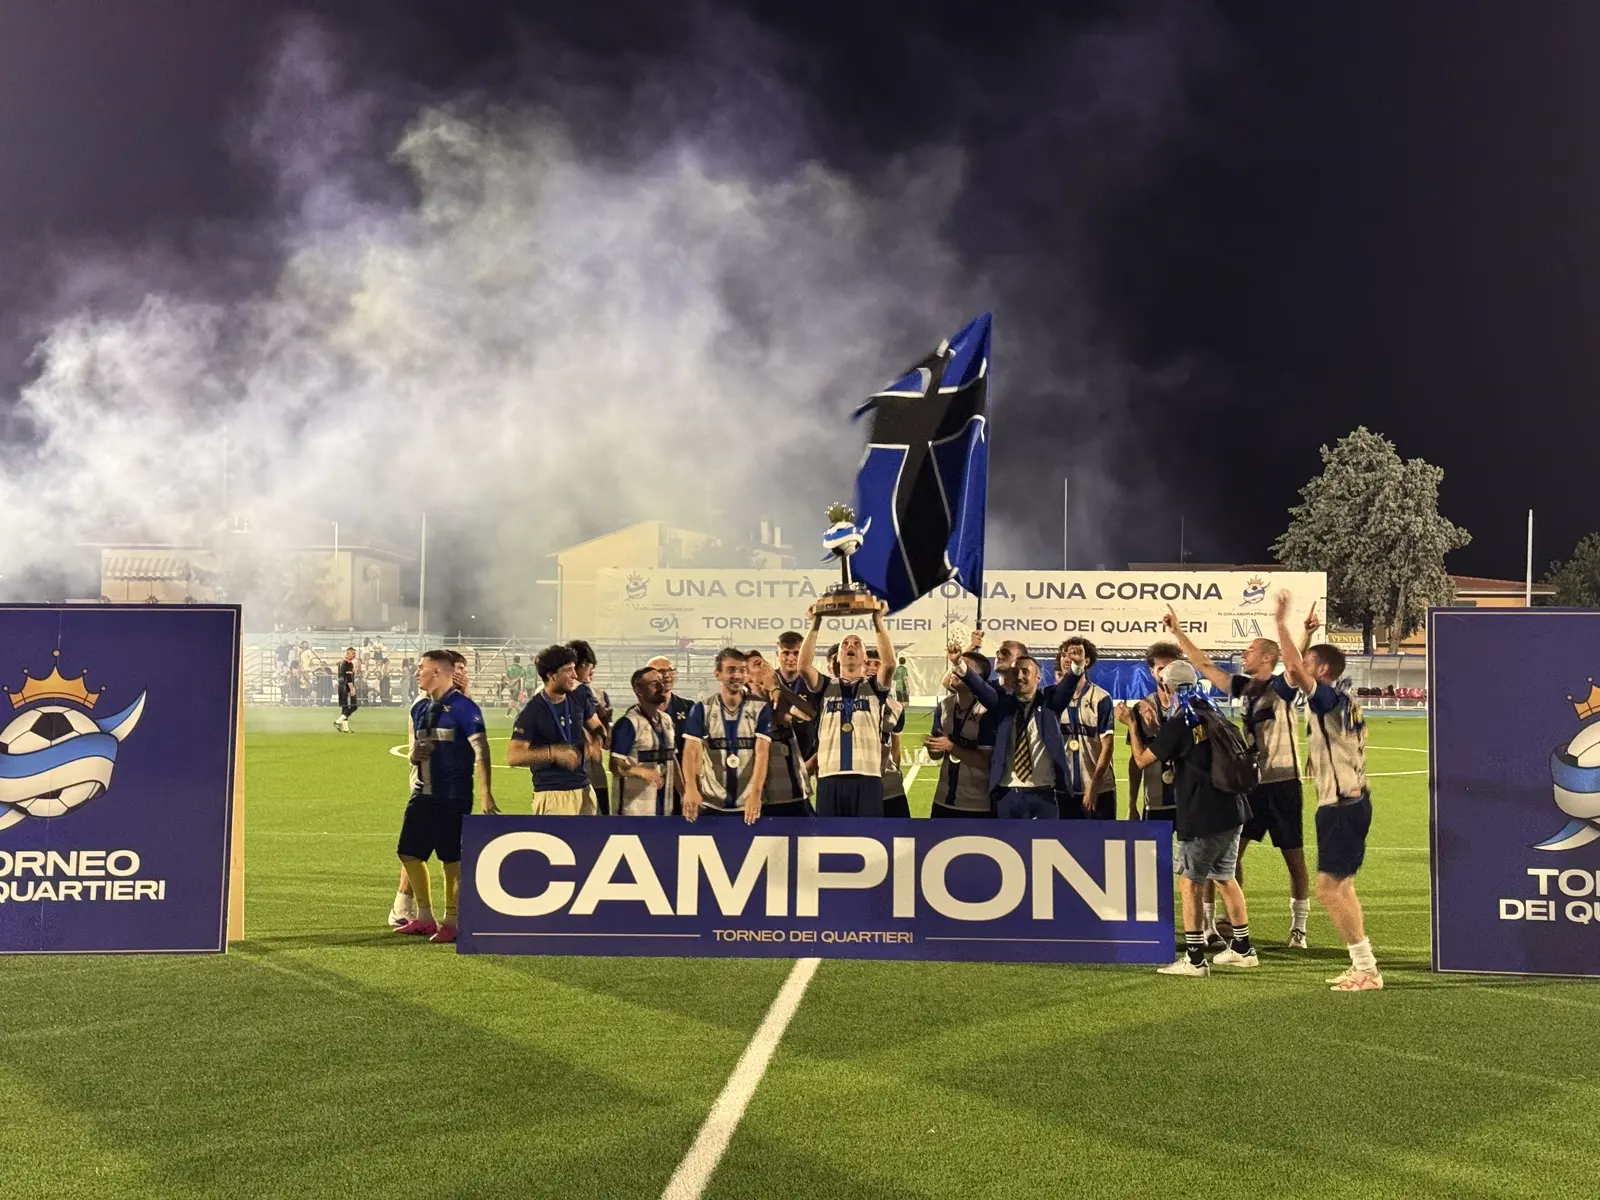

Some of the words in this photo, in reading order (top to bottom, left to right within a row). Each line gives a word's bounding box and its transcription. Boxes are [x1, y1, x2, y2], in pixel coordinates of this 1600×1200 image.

[665, 579, 727, 597] UNA
[1025, 581, 1087, 600] UNA
[1095, 581, 1223, 601] CORONA
[702, 616, 785, 630] TORNEO
[790, 617, 812, 631] DE
[1063, 619, 1095, 632] DEI
[475, 831, 1159, 922] CAMPIONI
[1527, 868, 1600, 897] TO
[1499, 899, 1556, 921] DEI
[712, 929, 786, 942] TORNEO
[789, 930, 818, 943] DEI
[820, 931, 914, 944] QUARTIERI
